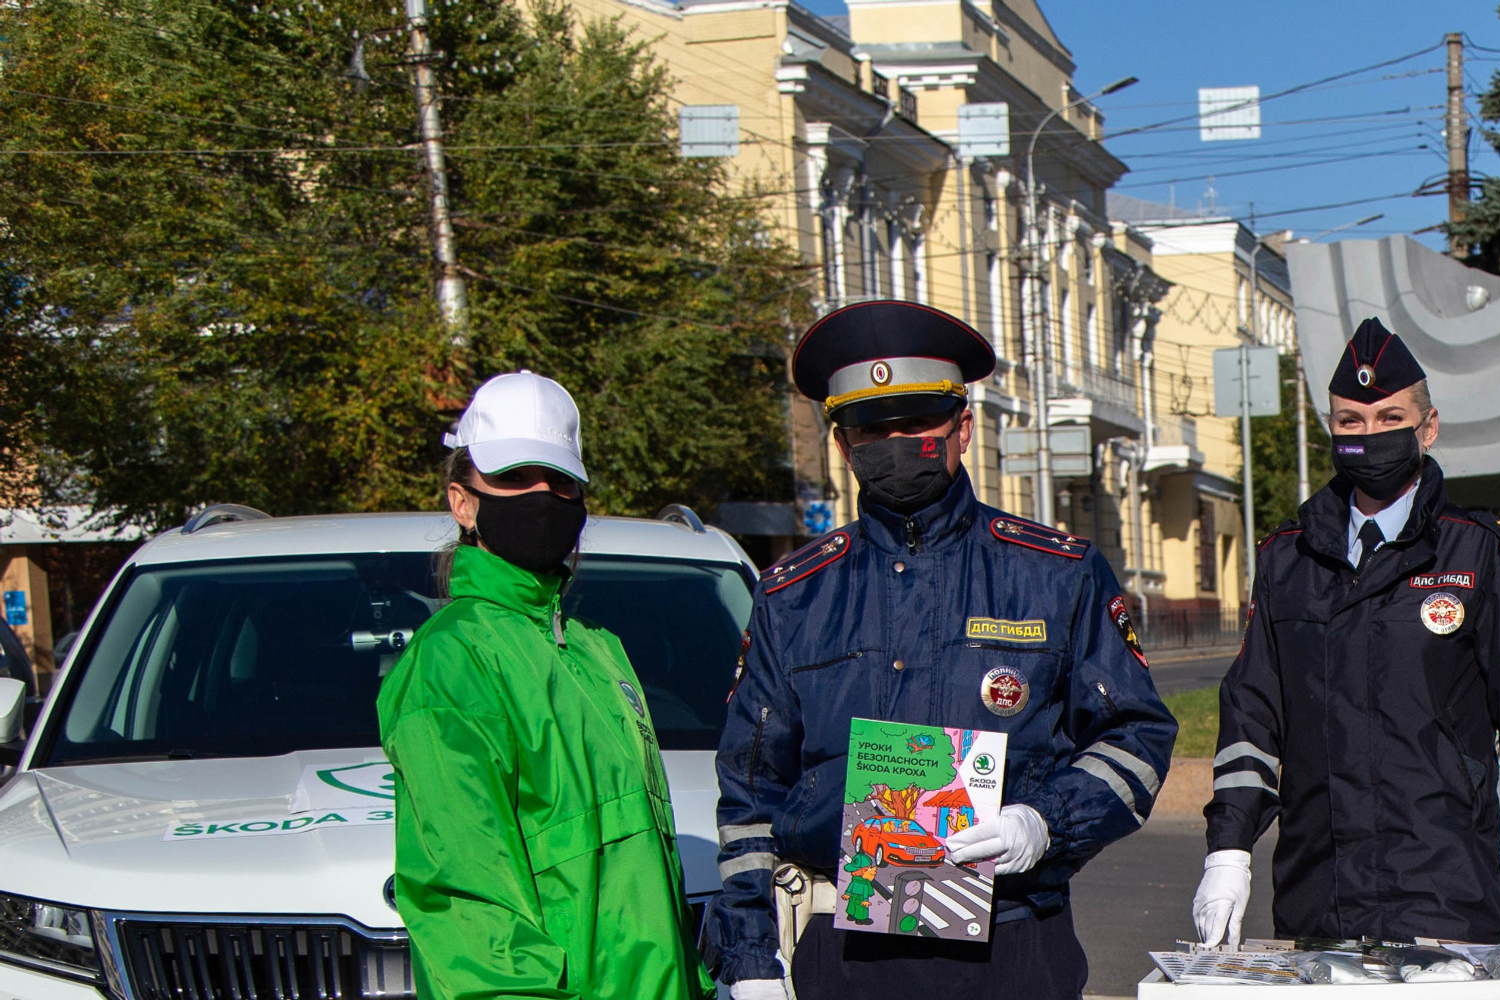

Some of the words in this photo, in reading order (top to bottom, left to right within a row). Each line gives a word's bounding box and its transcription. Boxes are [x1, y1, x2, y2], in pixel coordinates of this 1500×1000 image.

[1413, 576, 1435, 587] ДПС
[1437, 574, 1471, 587] ГИБДД
[971, 623, 998, 634] ДПС
[1000, 625, 1042, 638] ГИБДД
[996, 698, 1013, 707] ДПС
[859, 741, 892, 752] УРОКИ
[858, 752, 939, 768] БЕЗОПАСНОСТИ
[857, 761, 890, 774] ŠKODA
[893, 766, 926, 778] КРОХА
[173, 812, 348, 836] ŠKODA
